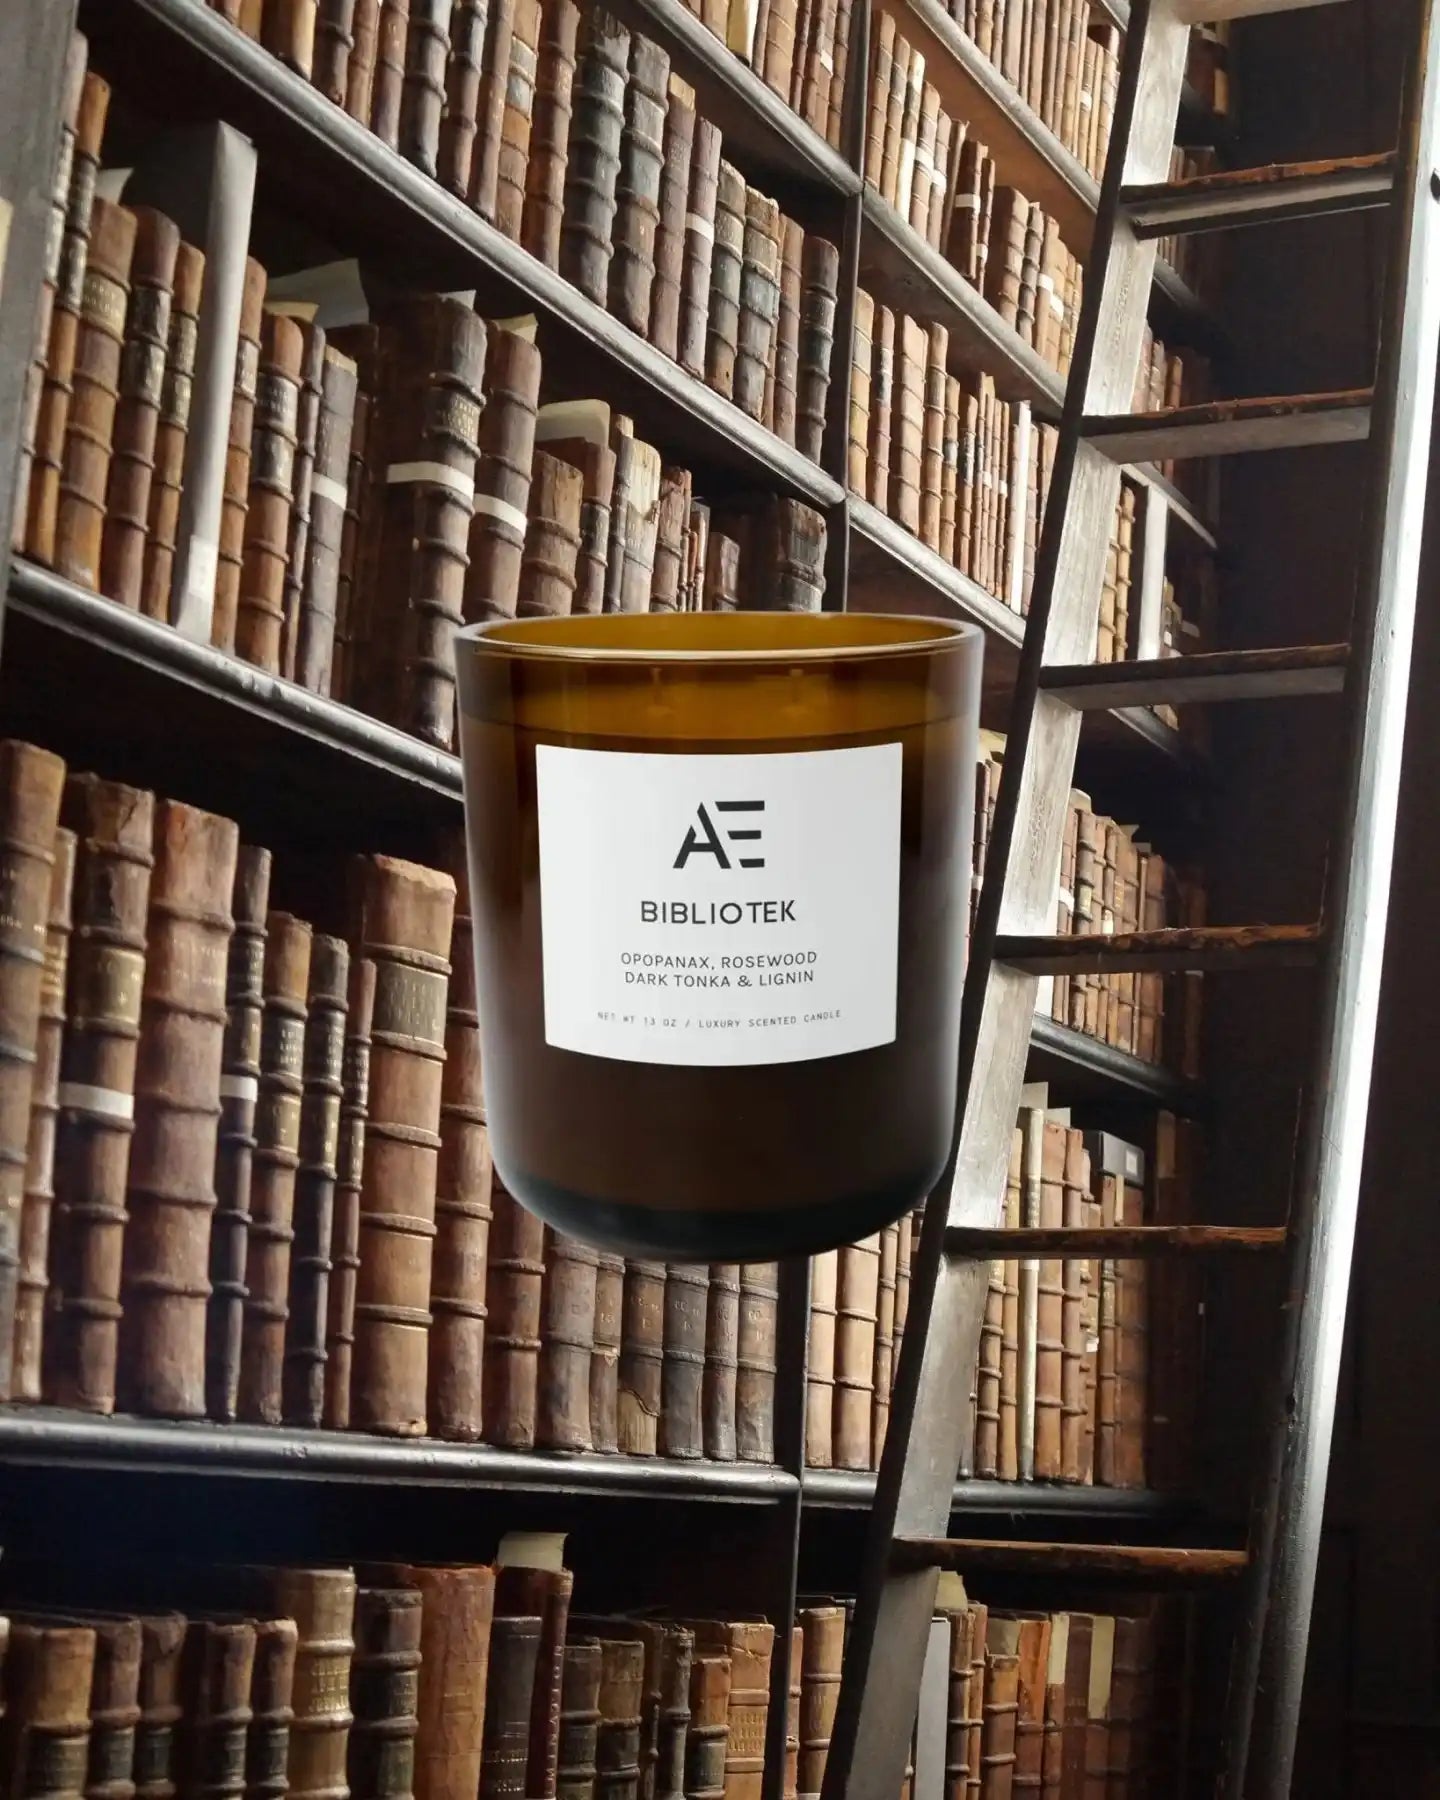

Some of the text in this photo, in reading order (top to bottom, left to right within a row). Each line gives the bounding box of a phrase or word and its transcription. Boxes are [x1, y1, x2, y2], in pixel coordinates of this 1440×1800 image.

[640, 900, 797, 925] BIBLIOTEK
[621, 952, 817, 971] OPOPANAX, ROSEWOOD
[624, 969, 815, 988] DARK TONKA & LIGNIN
[597, 1011, 616, 1022] NET
[644, 1017, 657, 1027] 13
[662, 1018, 678, 1028] OZ
[684, 1018, 691, 1029] /
[698, 1019, 741, 1030] LUXURY
[748, 1015, 797, 1028] SCENTED
[803, 1009, 841, 1023] CANDLE
